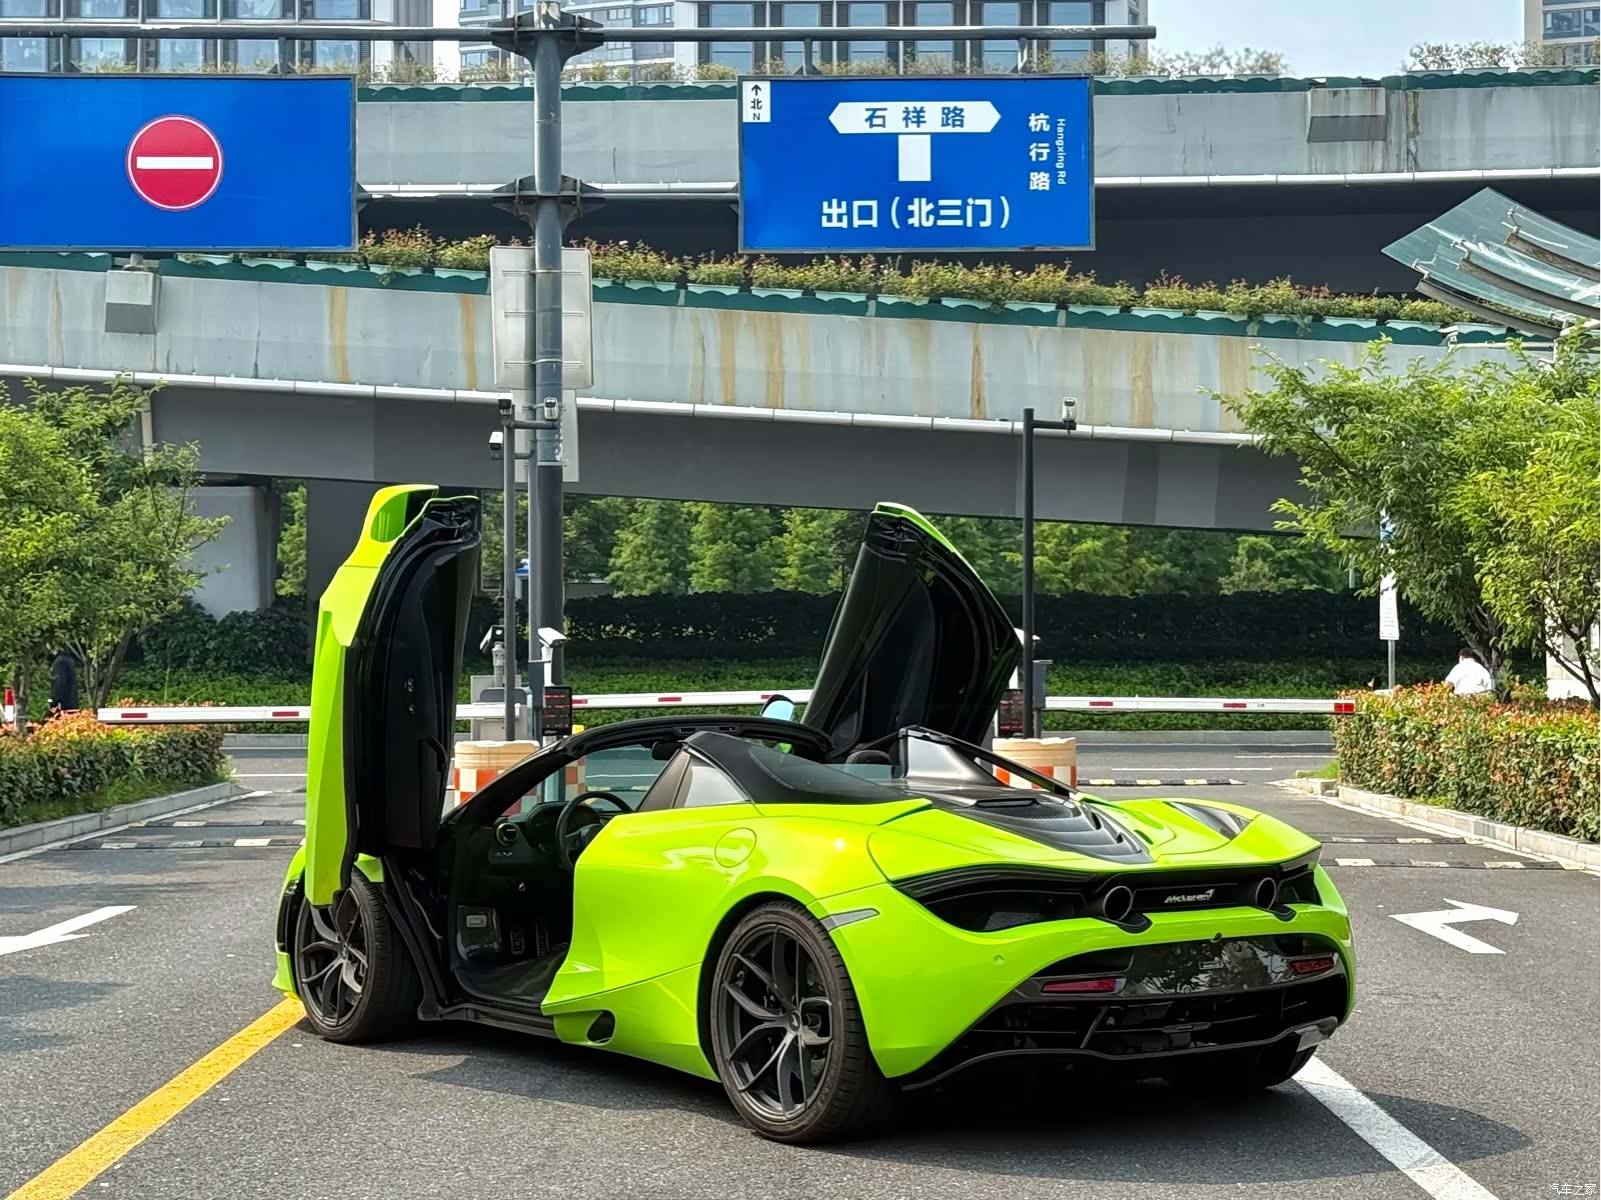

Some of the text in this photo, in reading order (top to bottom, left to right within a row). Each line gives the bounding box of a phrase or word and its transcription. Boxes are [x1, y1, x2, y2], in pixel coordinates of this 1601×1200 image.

[750, 97, 763, 110] 北
[752, 112, 761, 121] N
[864, 105, 966, 129] 石祥路
[1028, 112, 1051, 191] 杭行路
[1055, 118, 1067, 185] Hangxing Rd
